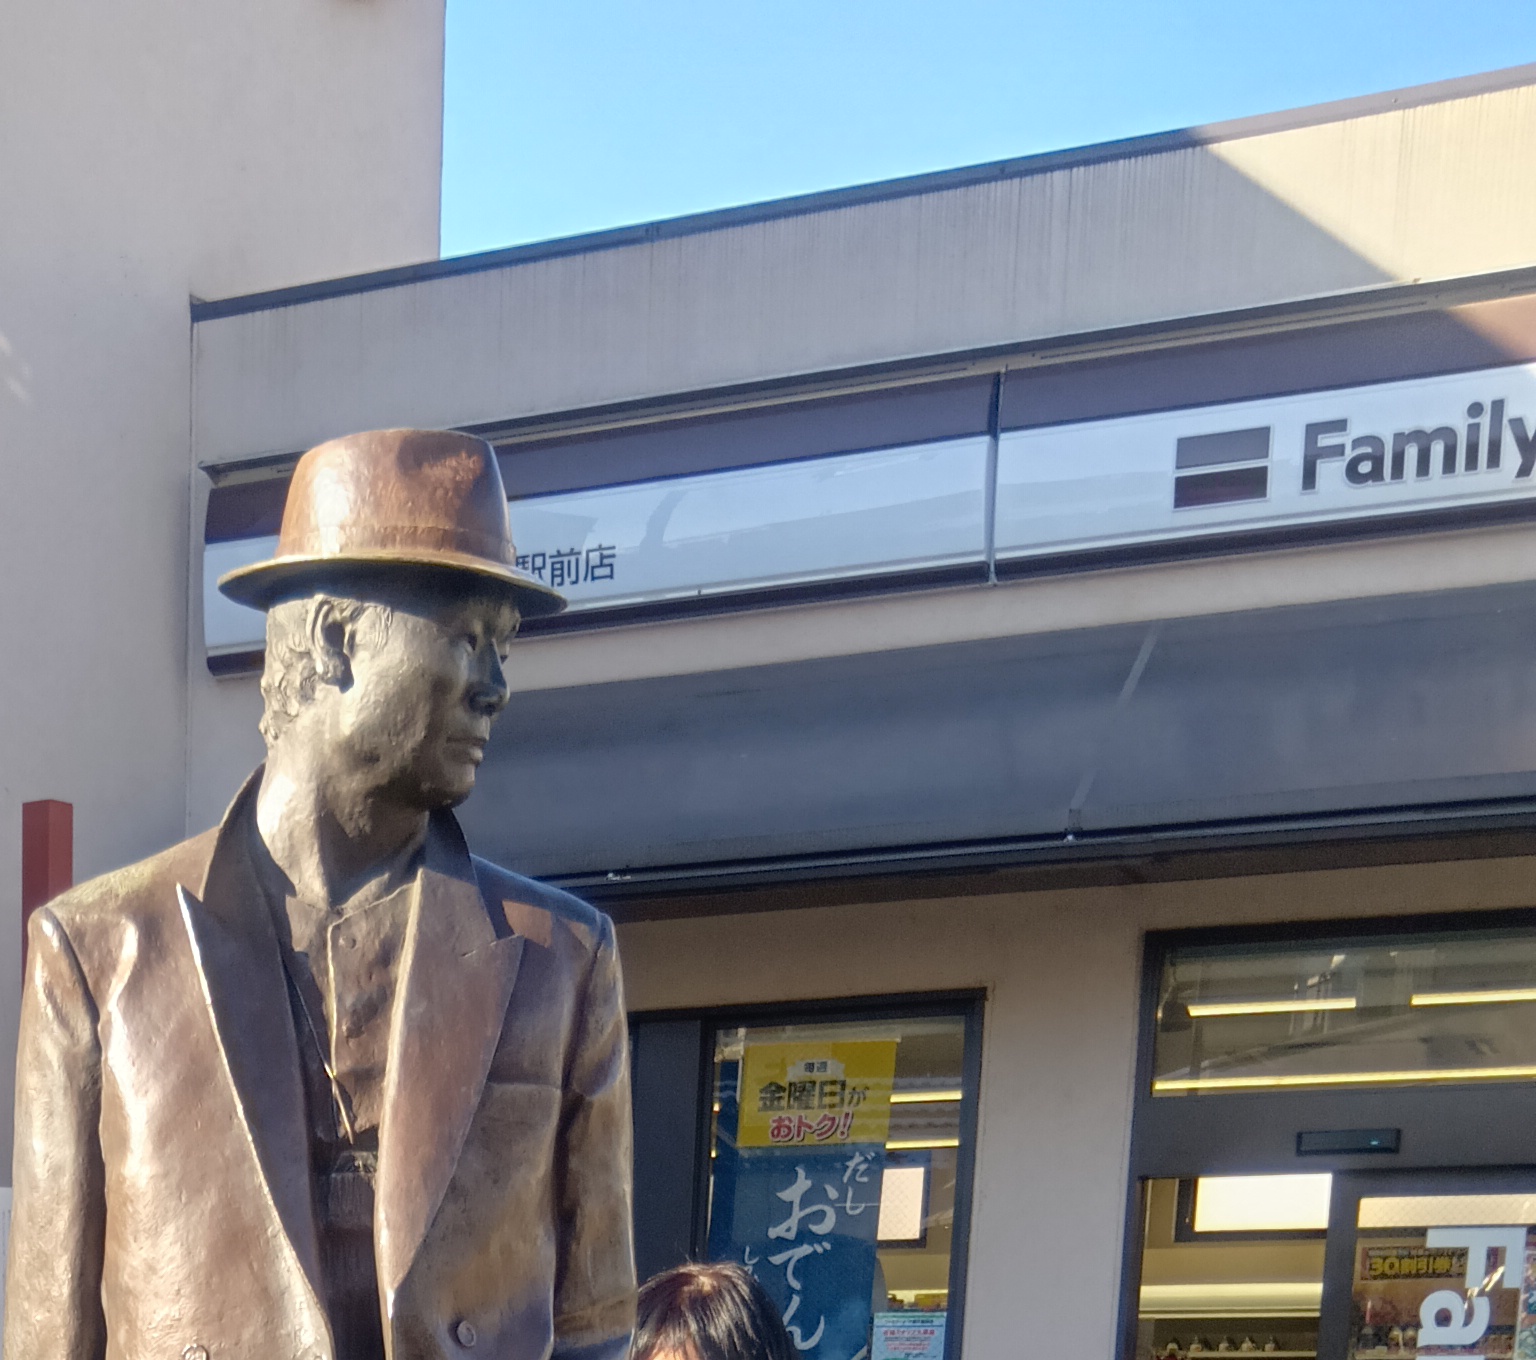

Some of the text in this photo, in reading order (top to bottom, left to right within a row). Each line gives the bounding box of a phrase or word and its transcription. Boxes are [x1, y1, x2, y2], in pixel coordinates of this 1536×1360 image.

[758, 1080, 869, 1112] 金曜日が
[767, 1167, 839, 1351] おでん
